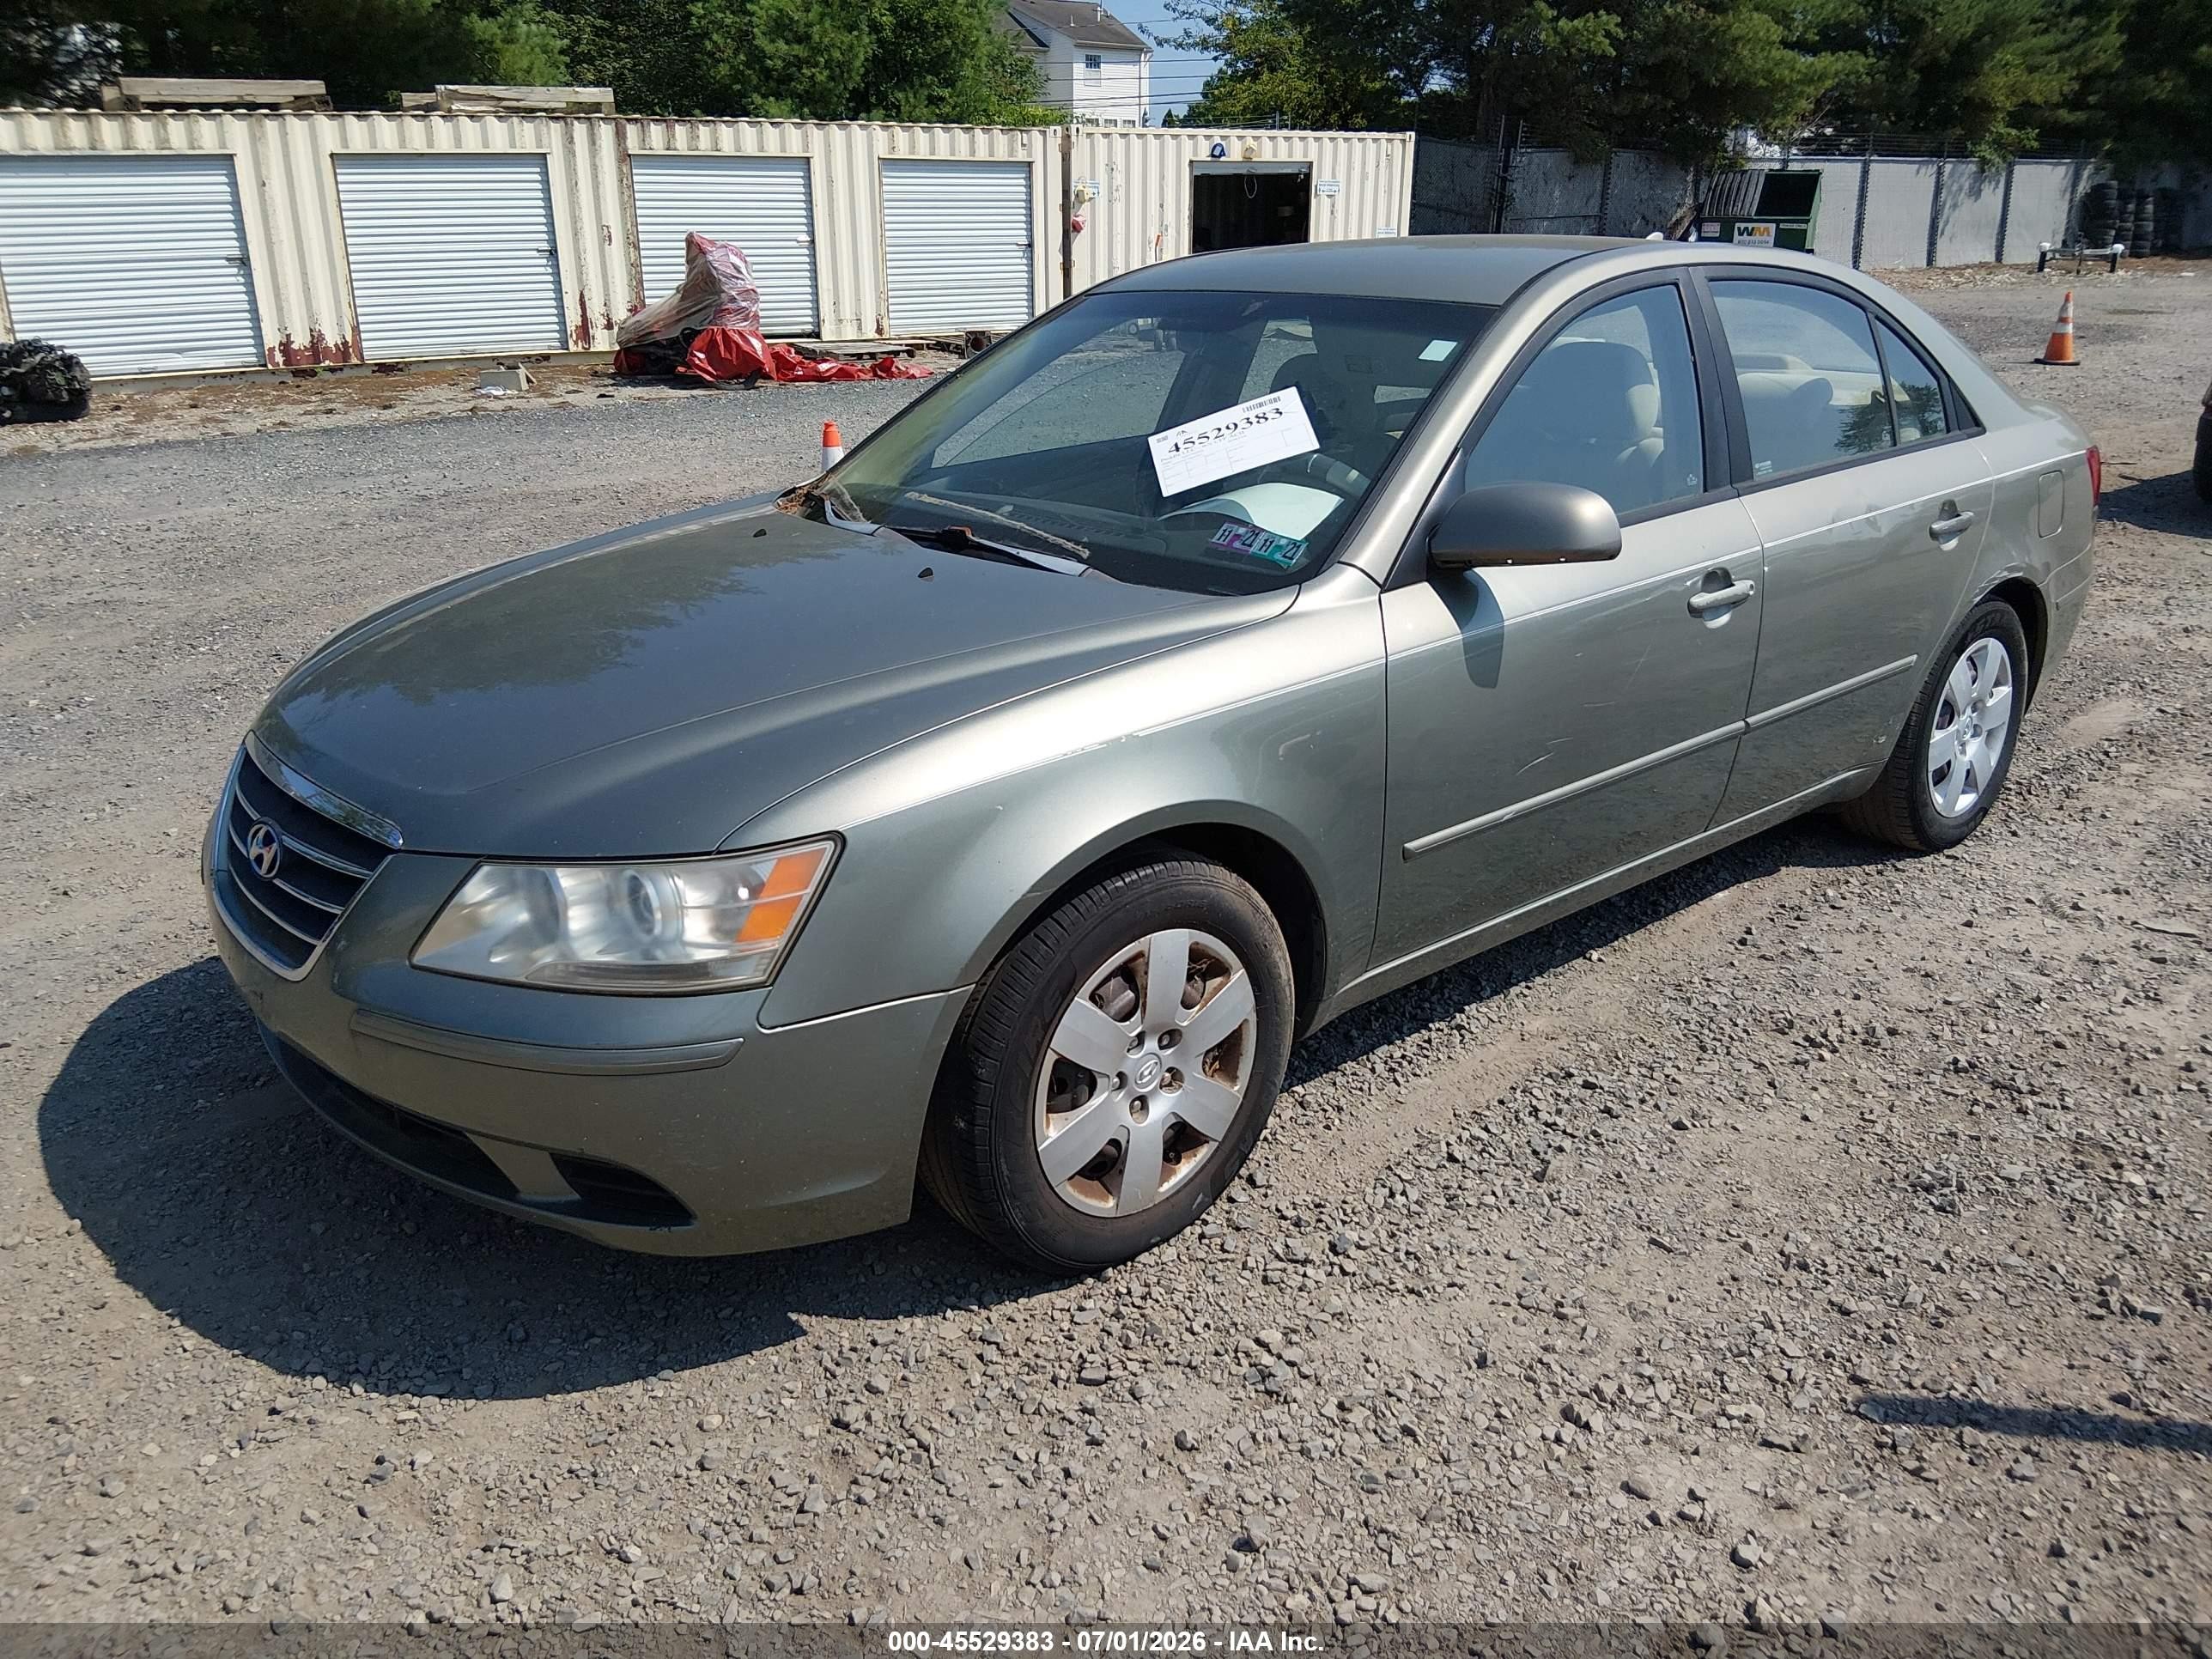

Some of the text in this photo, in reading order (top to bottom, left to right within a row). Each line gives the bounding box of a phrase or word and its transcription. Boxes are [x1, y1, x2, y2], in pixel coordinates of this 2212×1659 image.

[1736, 226, 1771, 236] WM
[1168, 407, 1284, 454] 45529383
[1242, 529, 1261, 548] 21
[1281, 541, 1303, 561] 21
